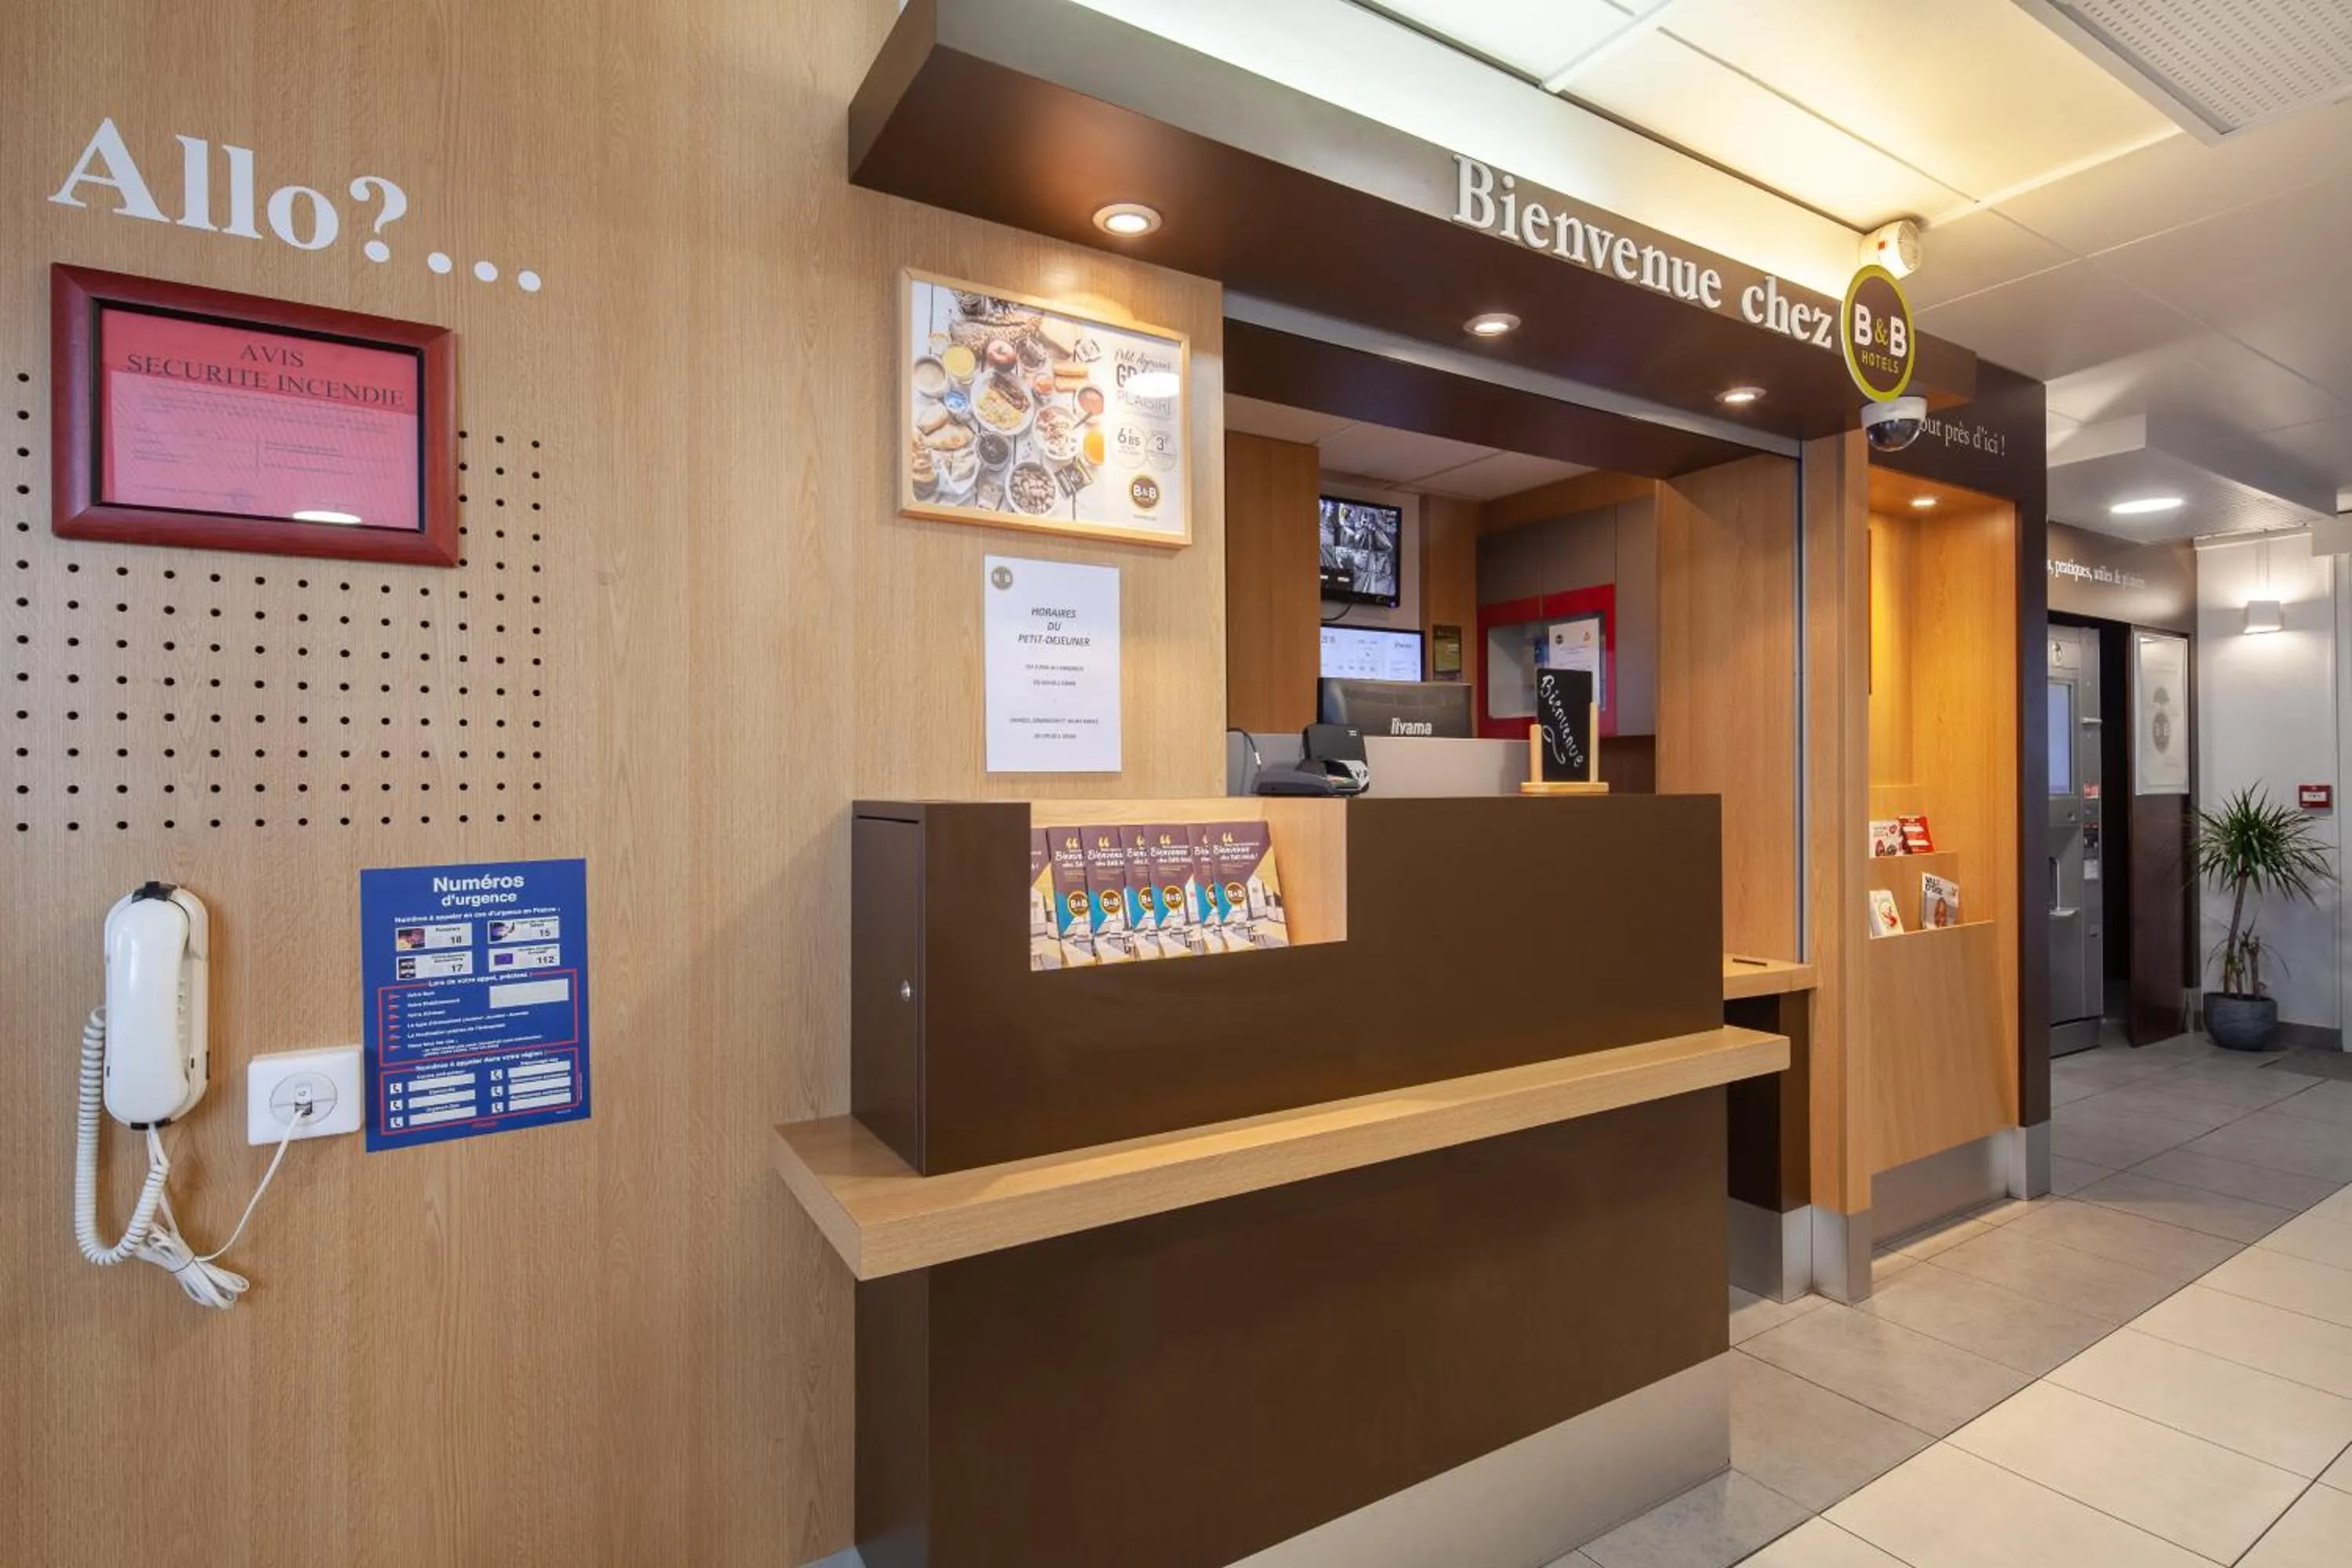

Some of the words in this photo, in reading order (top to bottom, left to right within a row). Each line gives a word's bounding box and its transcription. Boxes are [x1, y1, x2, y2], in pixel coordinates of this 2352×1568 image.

[1450, 153, 1722, 309] Bienvenue
[1741, 274, 1832, 349] chez
[1855, 303, 1907, 358] B&B
[240, 343, 305, 368] AVIS
[1861, 350, 1900, 374] HOTELS
[126, 352, 269, 390] SECURITE
[278, 374, 405, 407] INCENDIE
[1921, 417, 1940, 436] out
[1945, 422, 1970, 447] près
[1973, 426, 1998, 455] d'ici
[1031, 607, 1076, 619] HORAIRES
[1047, 622, 1062, 631] DU
[1539, 674, 1584, 768] Bienvenue
[434, 873, 524, 893] Numéros
[441, 892, 517, 907] d'urgence
